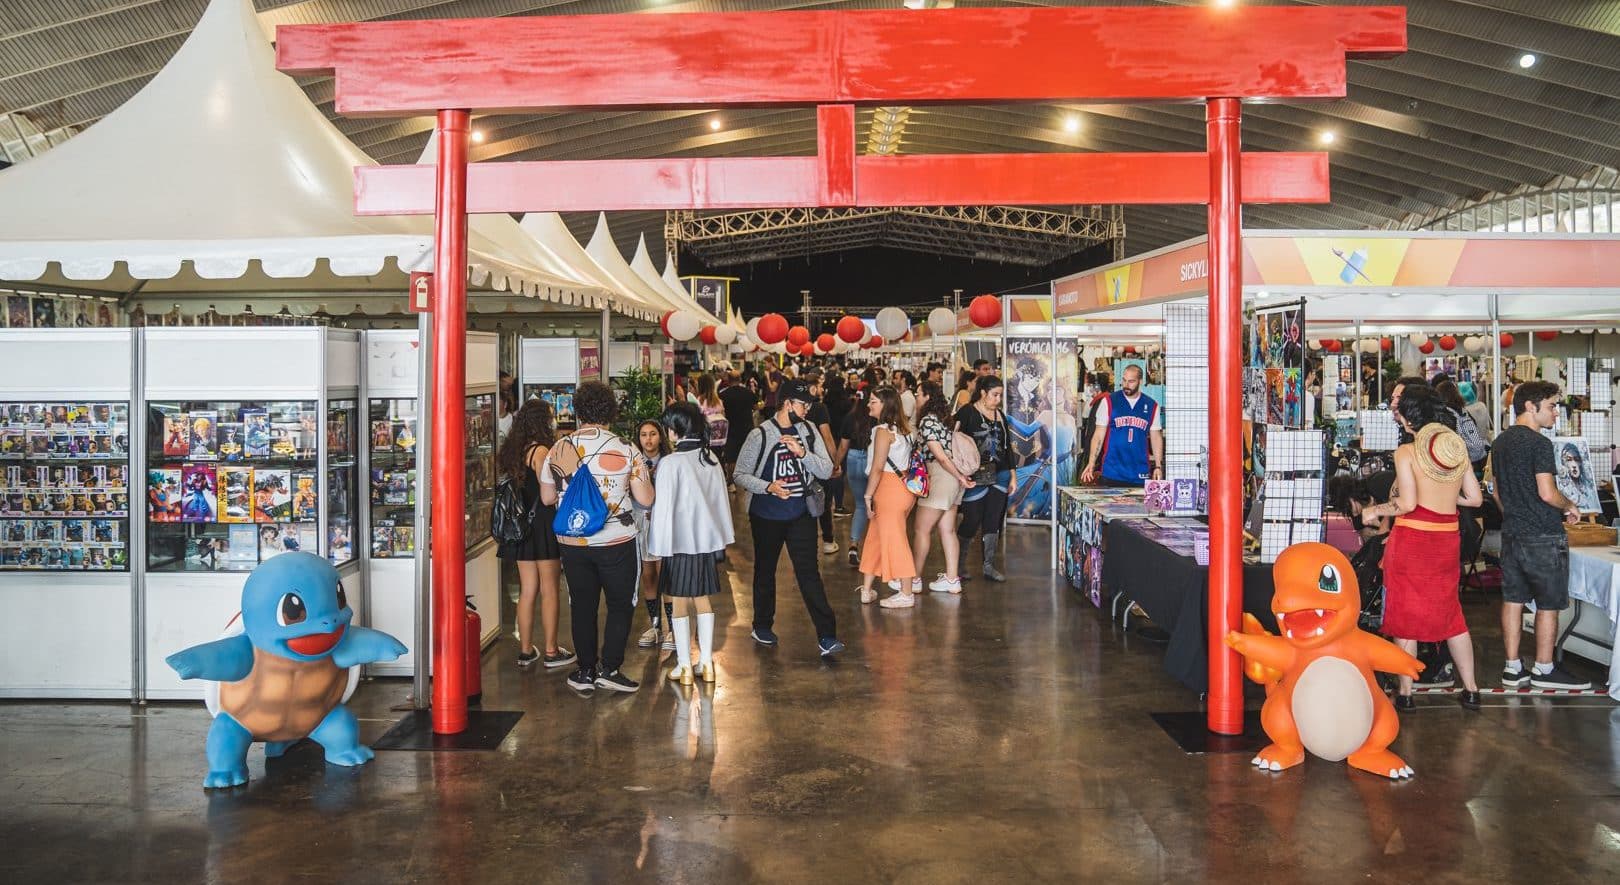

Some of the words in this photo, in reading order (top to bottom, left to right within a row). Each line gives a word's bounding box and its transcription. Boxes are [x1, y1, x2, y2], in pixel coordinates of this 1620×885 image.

[1008, 339, 1053, 354] VERÓNICA
[1114, 415, 1149, 431] DETROIT
[1127, 428, 1134, 443] 1
